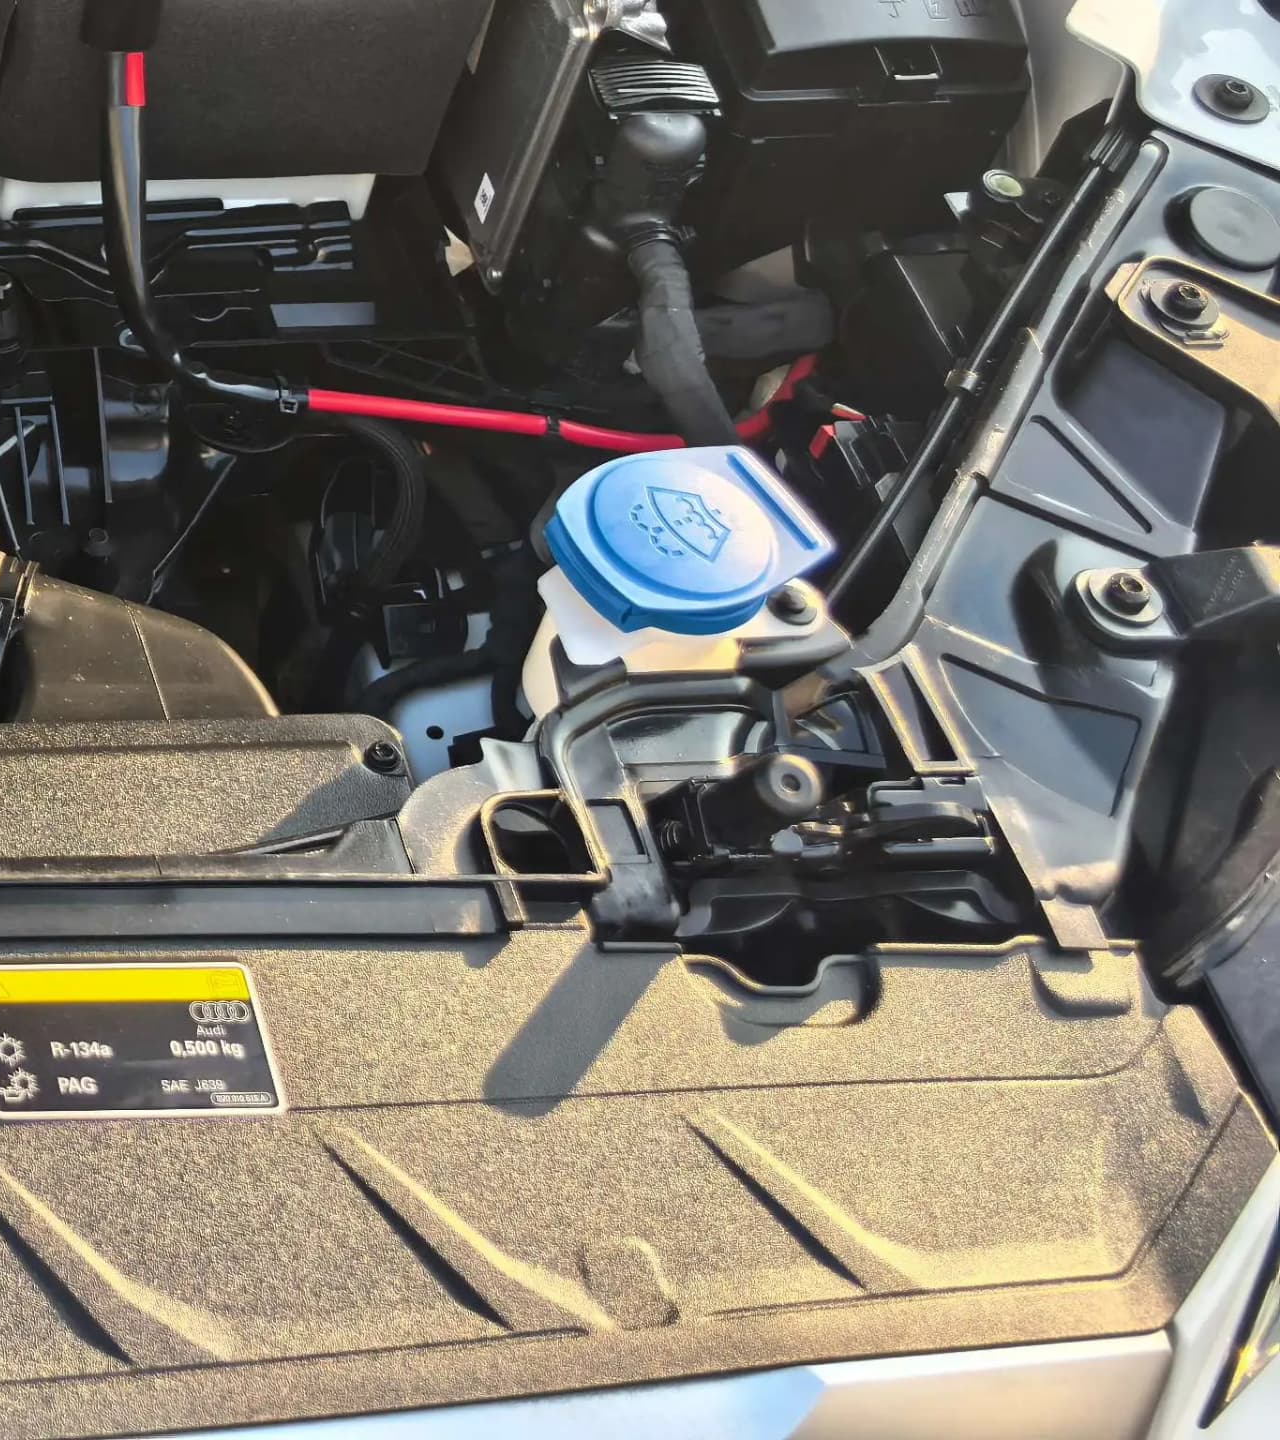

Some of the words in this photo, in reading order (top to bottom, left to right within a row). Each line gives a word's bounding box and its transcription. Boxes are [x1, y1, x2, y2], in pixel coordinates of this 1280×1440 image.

[196, 1025, 227, 1036] Audi
[50, 1041, 113, 1058] R-134a
[169, 1040, 218, 1058] 0,500
[220, 1040, 245, 1058] kg
[57, 1076, 100, 1095] PAG
[160, 1079, 190, 1092] SAE
[194, 1079, 227, 1092] J639
